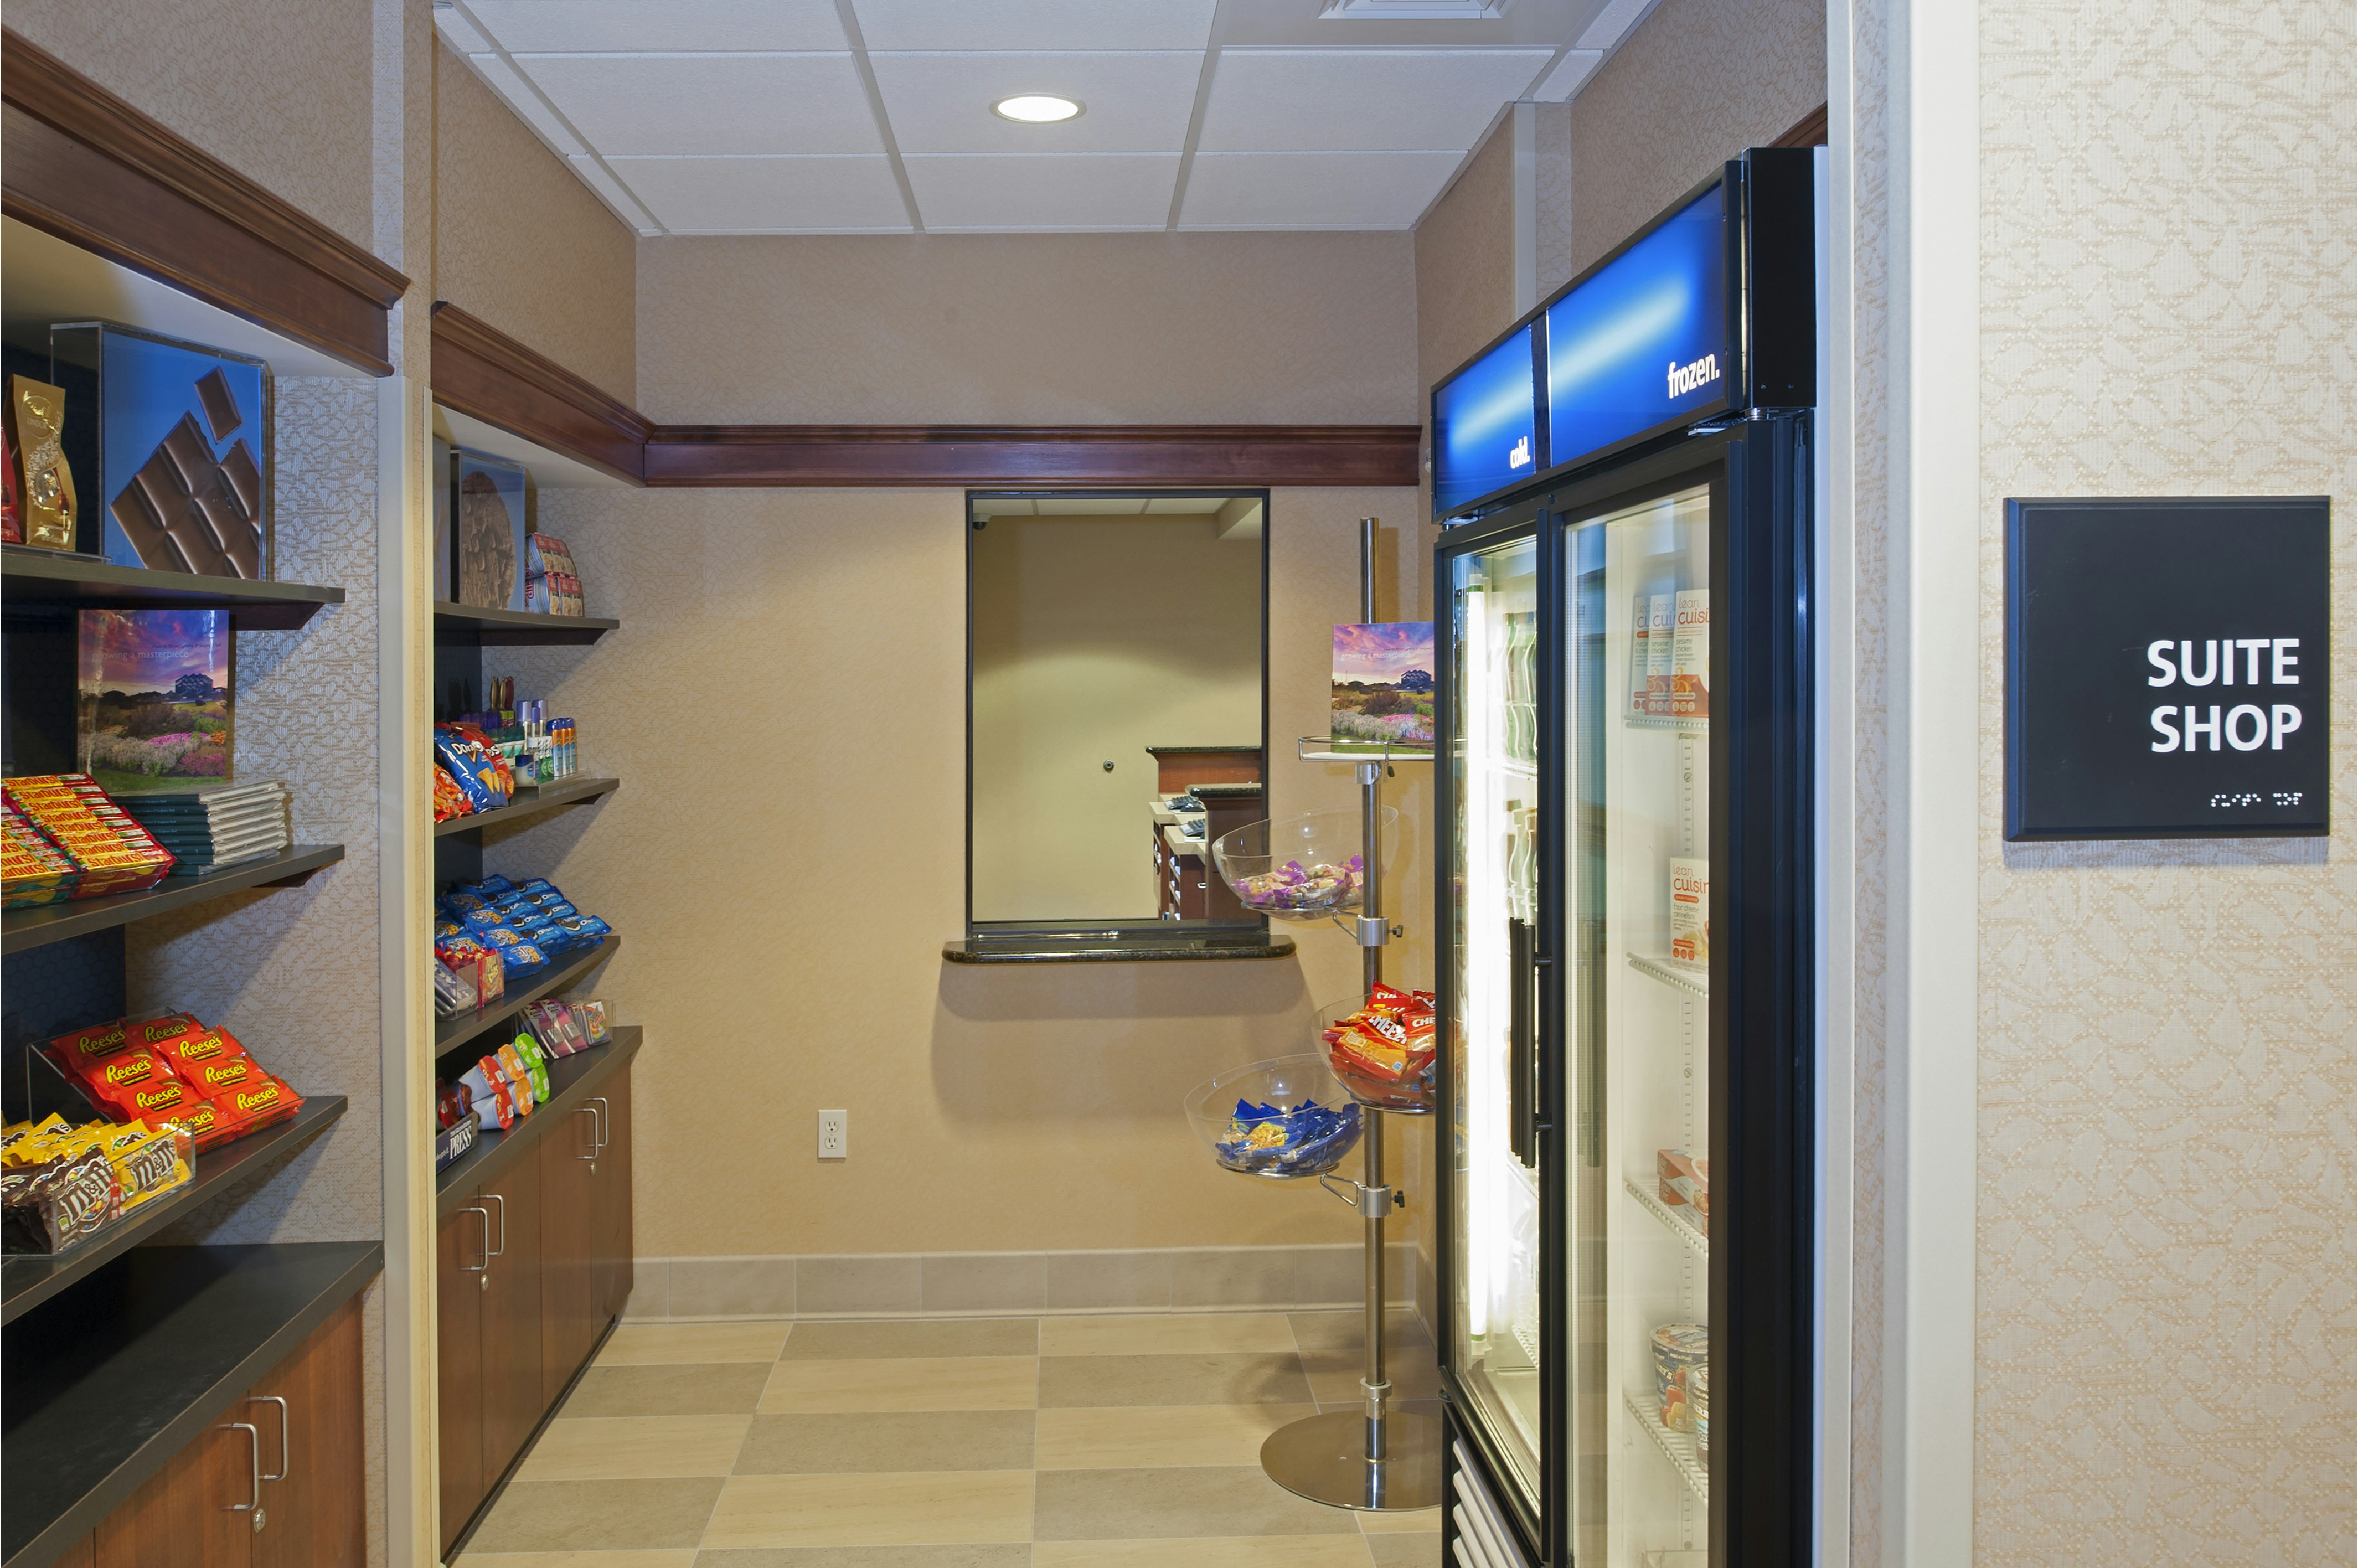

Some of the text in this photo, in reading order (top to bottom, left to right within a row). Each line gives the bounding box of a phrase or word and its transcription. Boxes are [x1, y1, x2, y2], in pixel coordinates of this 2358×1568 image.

[1668, 353, 1720, 399] frozen.
[1509, 436, 1530, 470] cold.
[1679, 597, 1700, 609] lean
[92, 651, 128, 661] growing
[139, 650, 189, 661] masterpiece
[2147, 638, 2299, 687] SUITE
[2150, 704, 2302, 752] SHOP
[5, 775, 57, 786] Starburst
[19, 788, 73, 799] Starburst
[29, 799, 81, 811] Starburst
[40, 809, 92, 823] Starburst
[54, 821, 105, 832] Starburst
[66, 831, 118, 844] Starburst
[74, 842, 126, 855] Starburst
[87, 852, 145, 867] Starburst
[1673, 864, 1694, 876] lean
[180, 1036, 222, 1058] Reese's
[106, 1059, 152, 1084] Reese's
[205, 1064, 247, 1083] Reese's
[136, 1086, 182, 1108] Reese's
[236, 1087, 278, 1110] Reese's
[450, 1125, 472, 1159] PRESS
